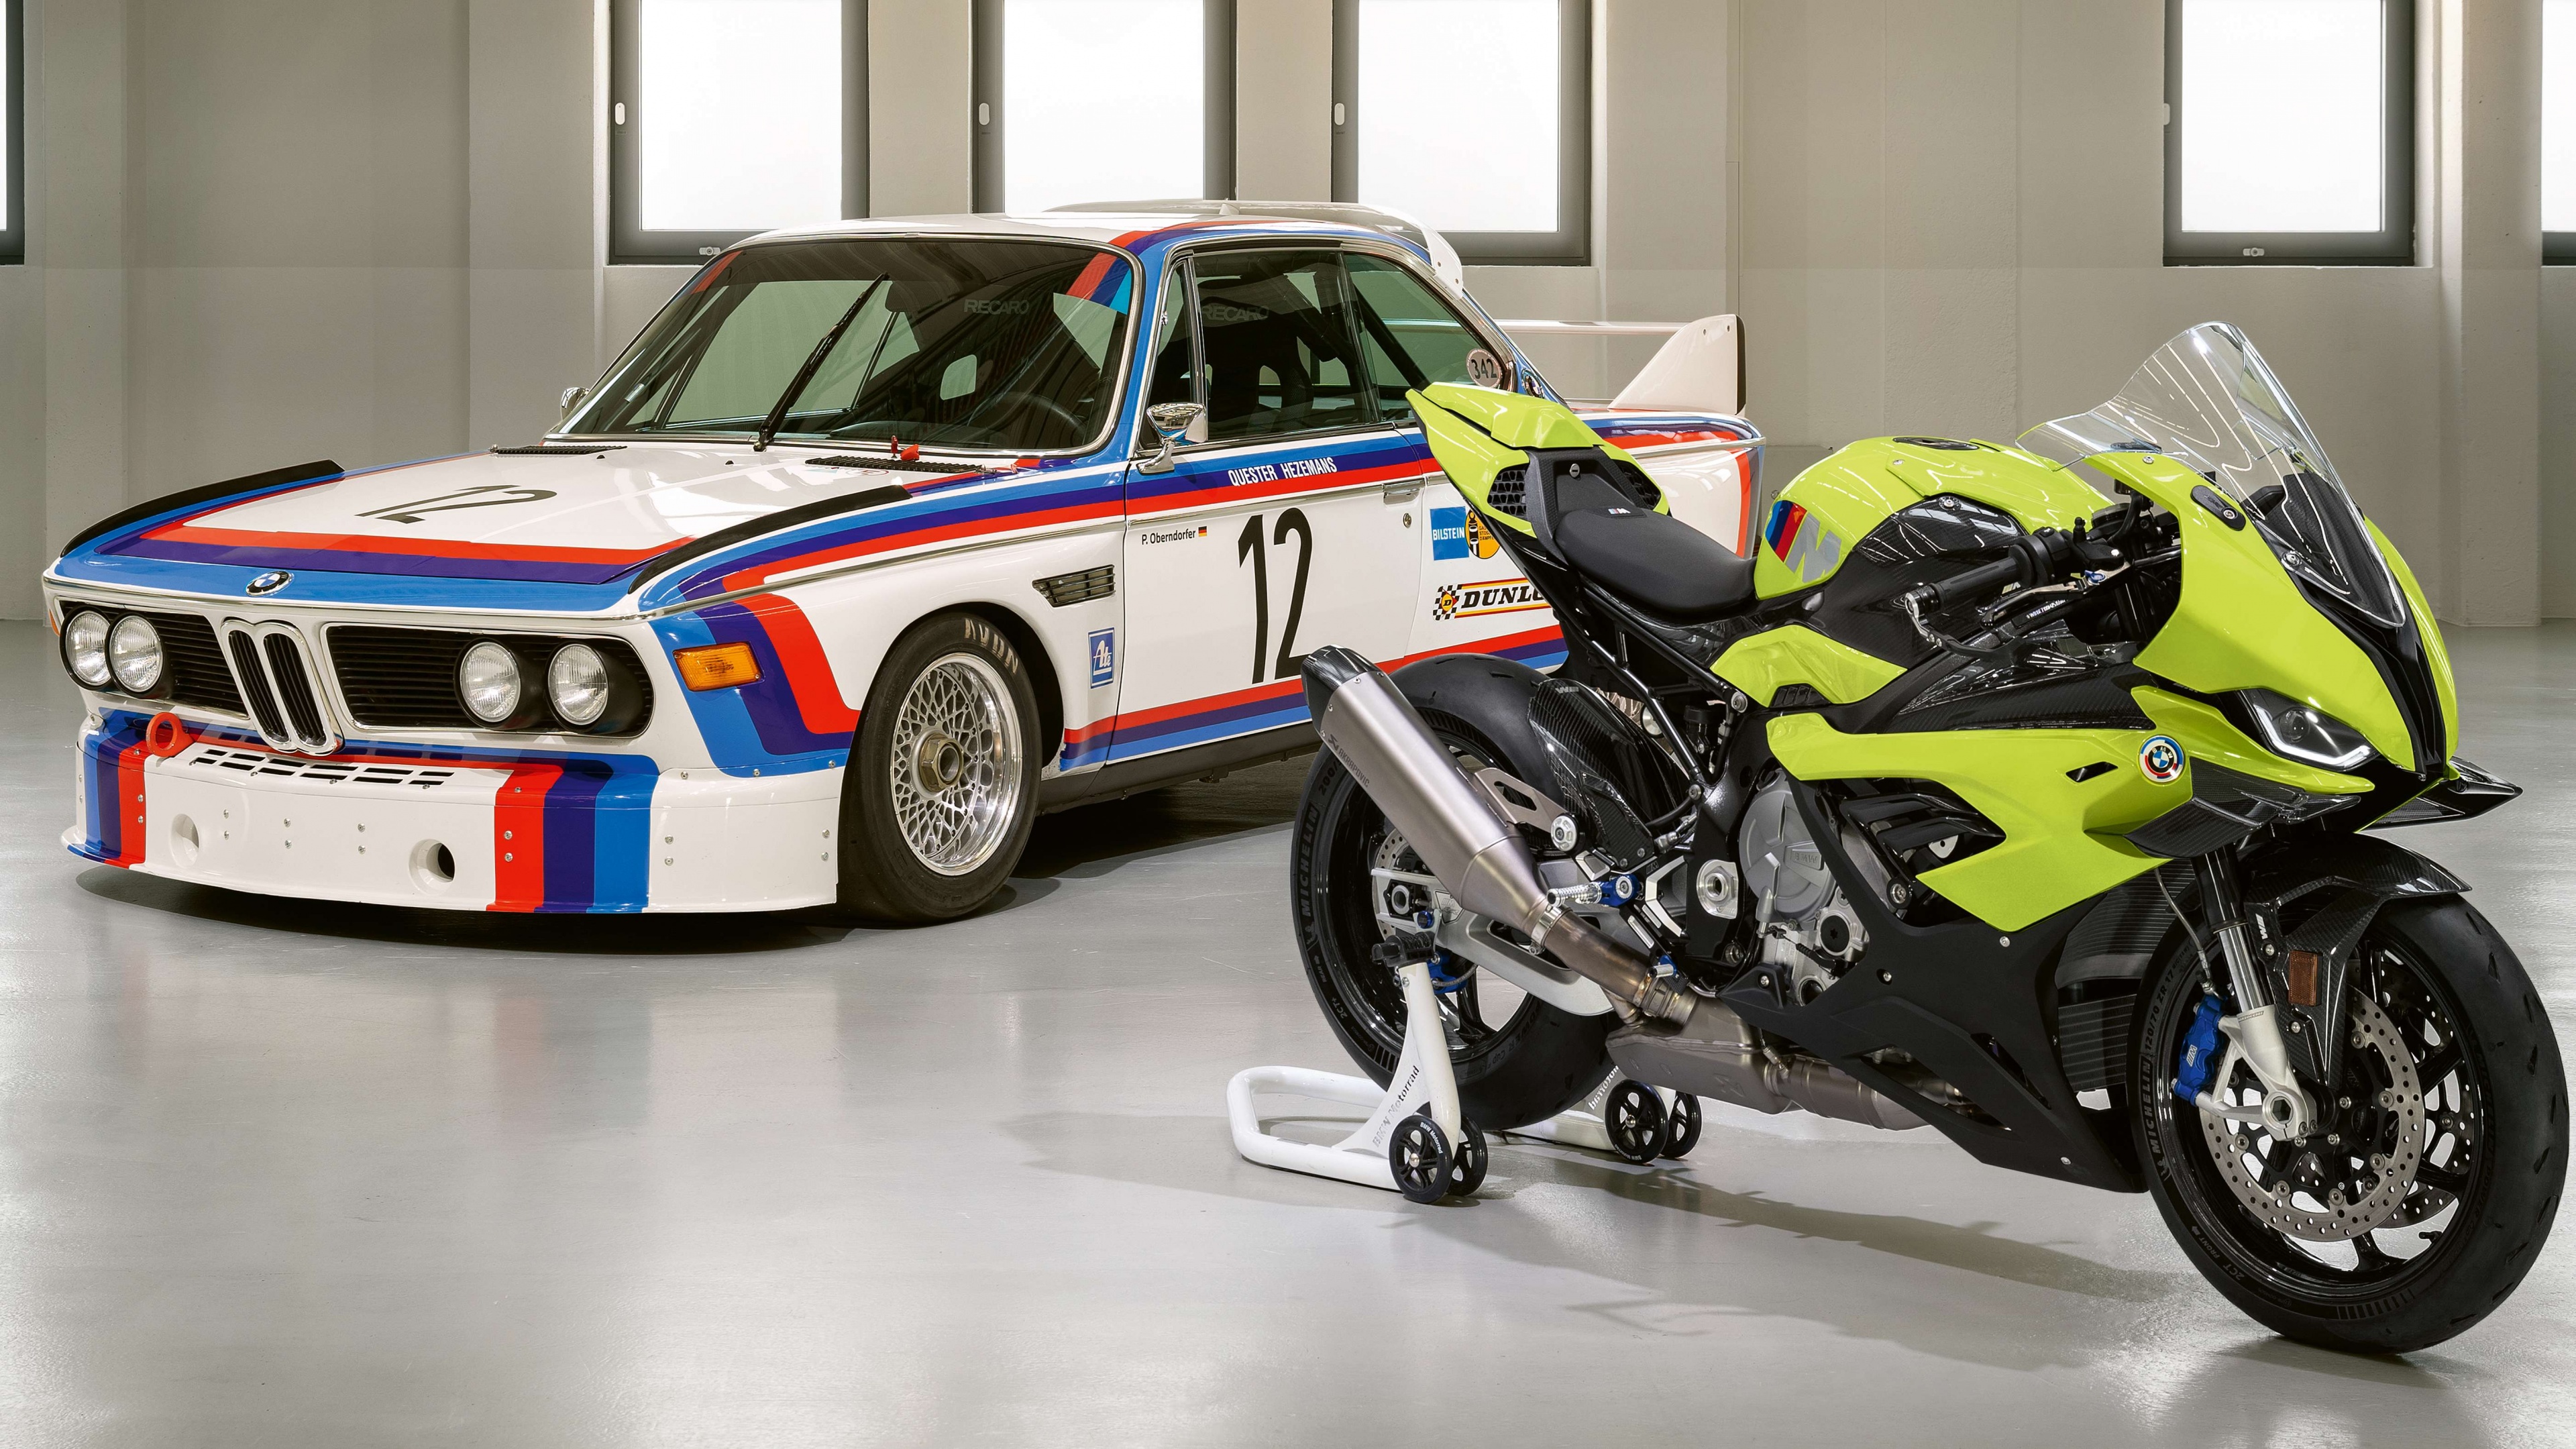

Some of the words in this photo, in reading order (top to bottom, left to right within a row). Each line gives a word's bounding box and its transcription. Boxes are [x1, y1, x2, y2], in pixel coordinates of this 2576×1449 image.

[964, 299, 1030, 315] RECARO
[1470, 358, 1497, 380] 342
[1228, 464, 1278, 487] QUESTER
[1280, 456, 1338, 479] HEZEMANS
[354, 484, 557, 524] 12
[1142, 534, 1148, 545] P.
[1150, 528, 1196, 544] Oberndorfer
[1432, 527, 1465, 541] BILSTEIN
[1238, 507, 1312, 684] 12
[1461, 586, 1544, 608] DUNL
[964, 617, 1018, 675] AVON
[2152, 746, 2174, 759] BMW
[1300, 806, 1318, 918] MICHELIN
[2145, 1004, 2160, 1051] 120/70
[2157, 984, 2167, 1004] ZR
[2165, 969, 2174, 983] 17
[1388, 1065, 1420, 1118] Motorrad
[2142, 1061, 2161, 1155] MICHELIN
[1420, 1122, 1432, 1132] BMW
[1430, 1130, 1444, 1155] Motorrad
[2199, 1237, 2220, 1259] FRONT
[2223, 1264, 2245, 1281] 2CT
